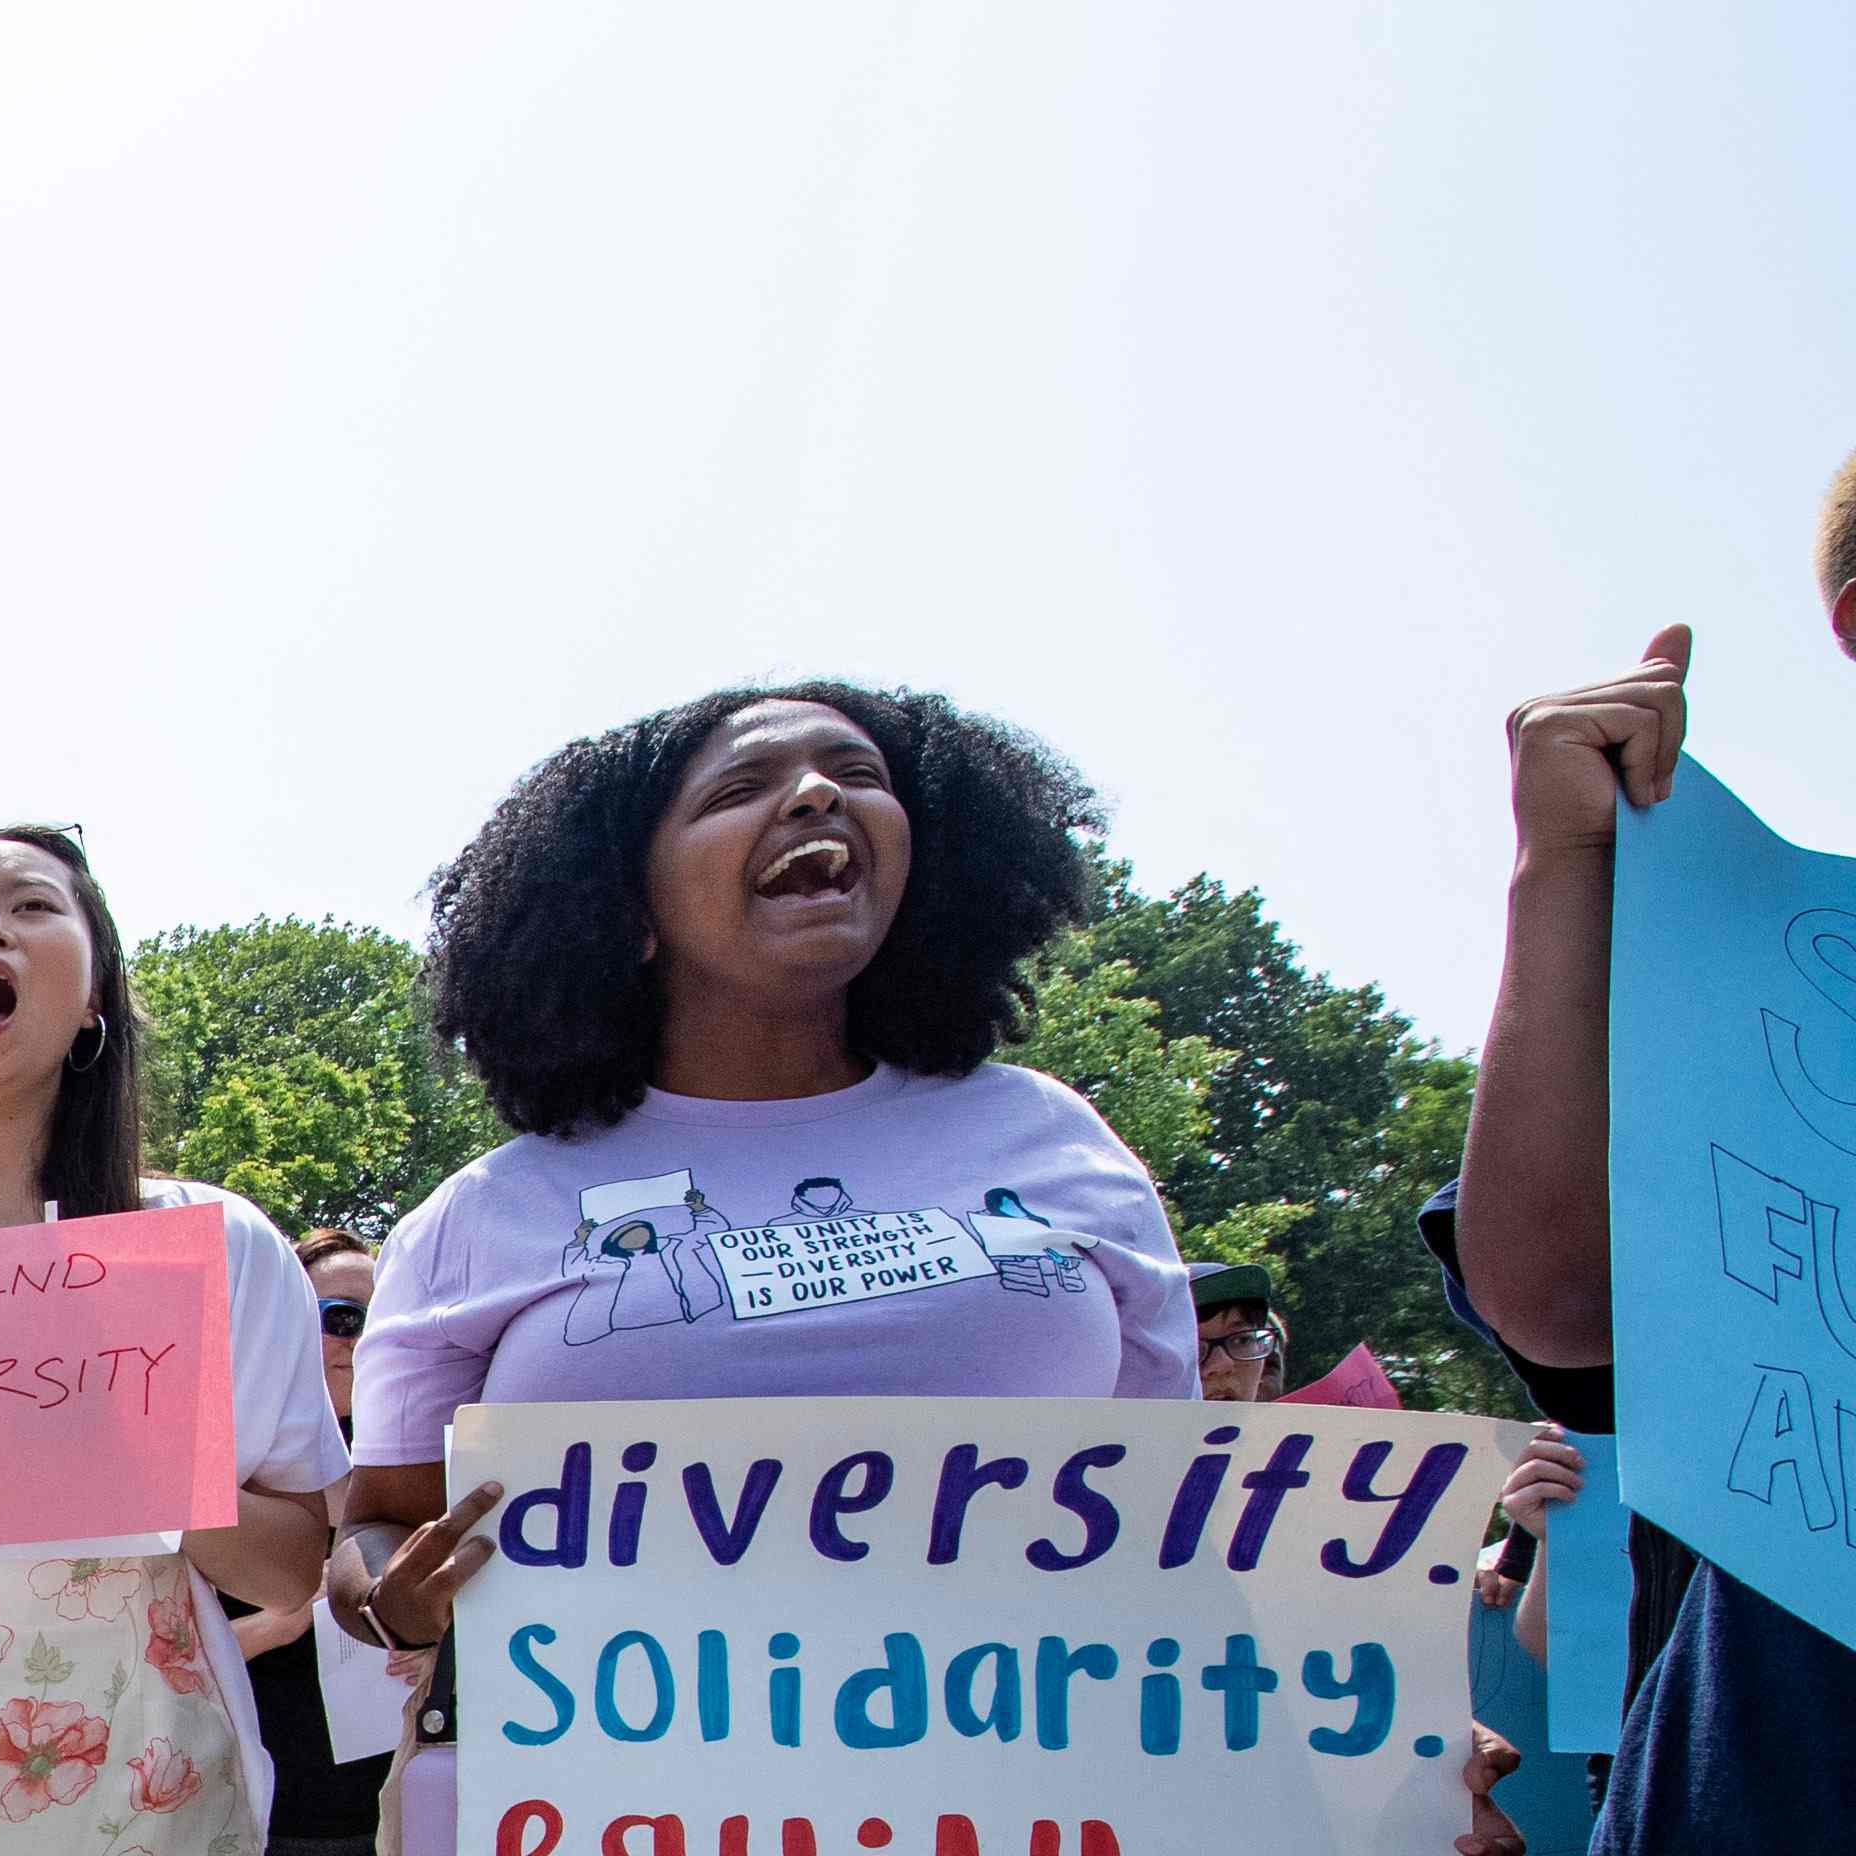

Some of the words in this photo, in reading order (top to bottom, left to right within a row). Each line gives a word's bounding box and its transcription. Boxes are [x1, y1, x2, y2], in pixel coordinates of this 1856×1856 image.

[719, 1228, 780, 1249] OUR
[795, 1216, 879, 1240] UNITY
[896, 1211, 925, 1225] IS
[741, 1242, 793, 1263] OUR
[804, 1222, 934, 1254] STRENGTH
[778, 1241, 918, 1280] DIVERSITY
[747, 1287, 773, 1309] IS
[792, 1278, 848, 1302] OUR
[862, 1255, 960, 1291] POWER
[496, 1424, 1470, 1586] diversity.
